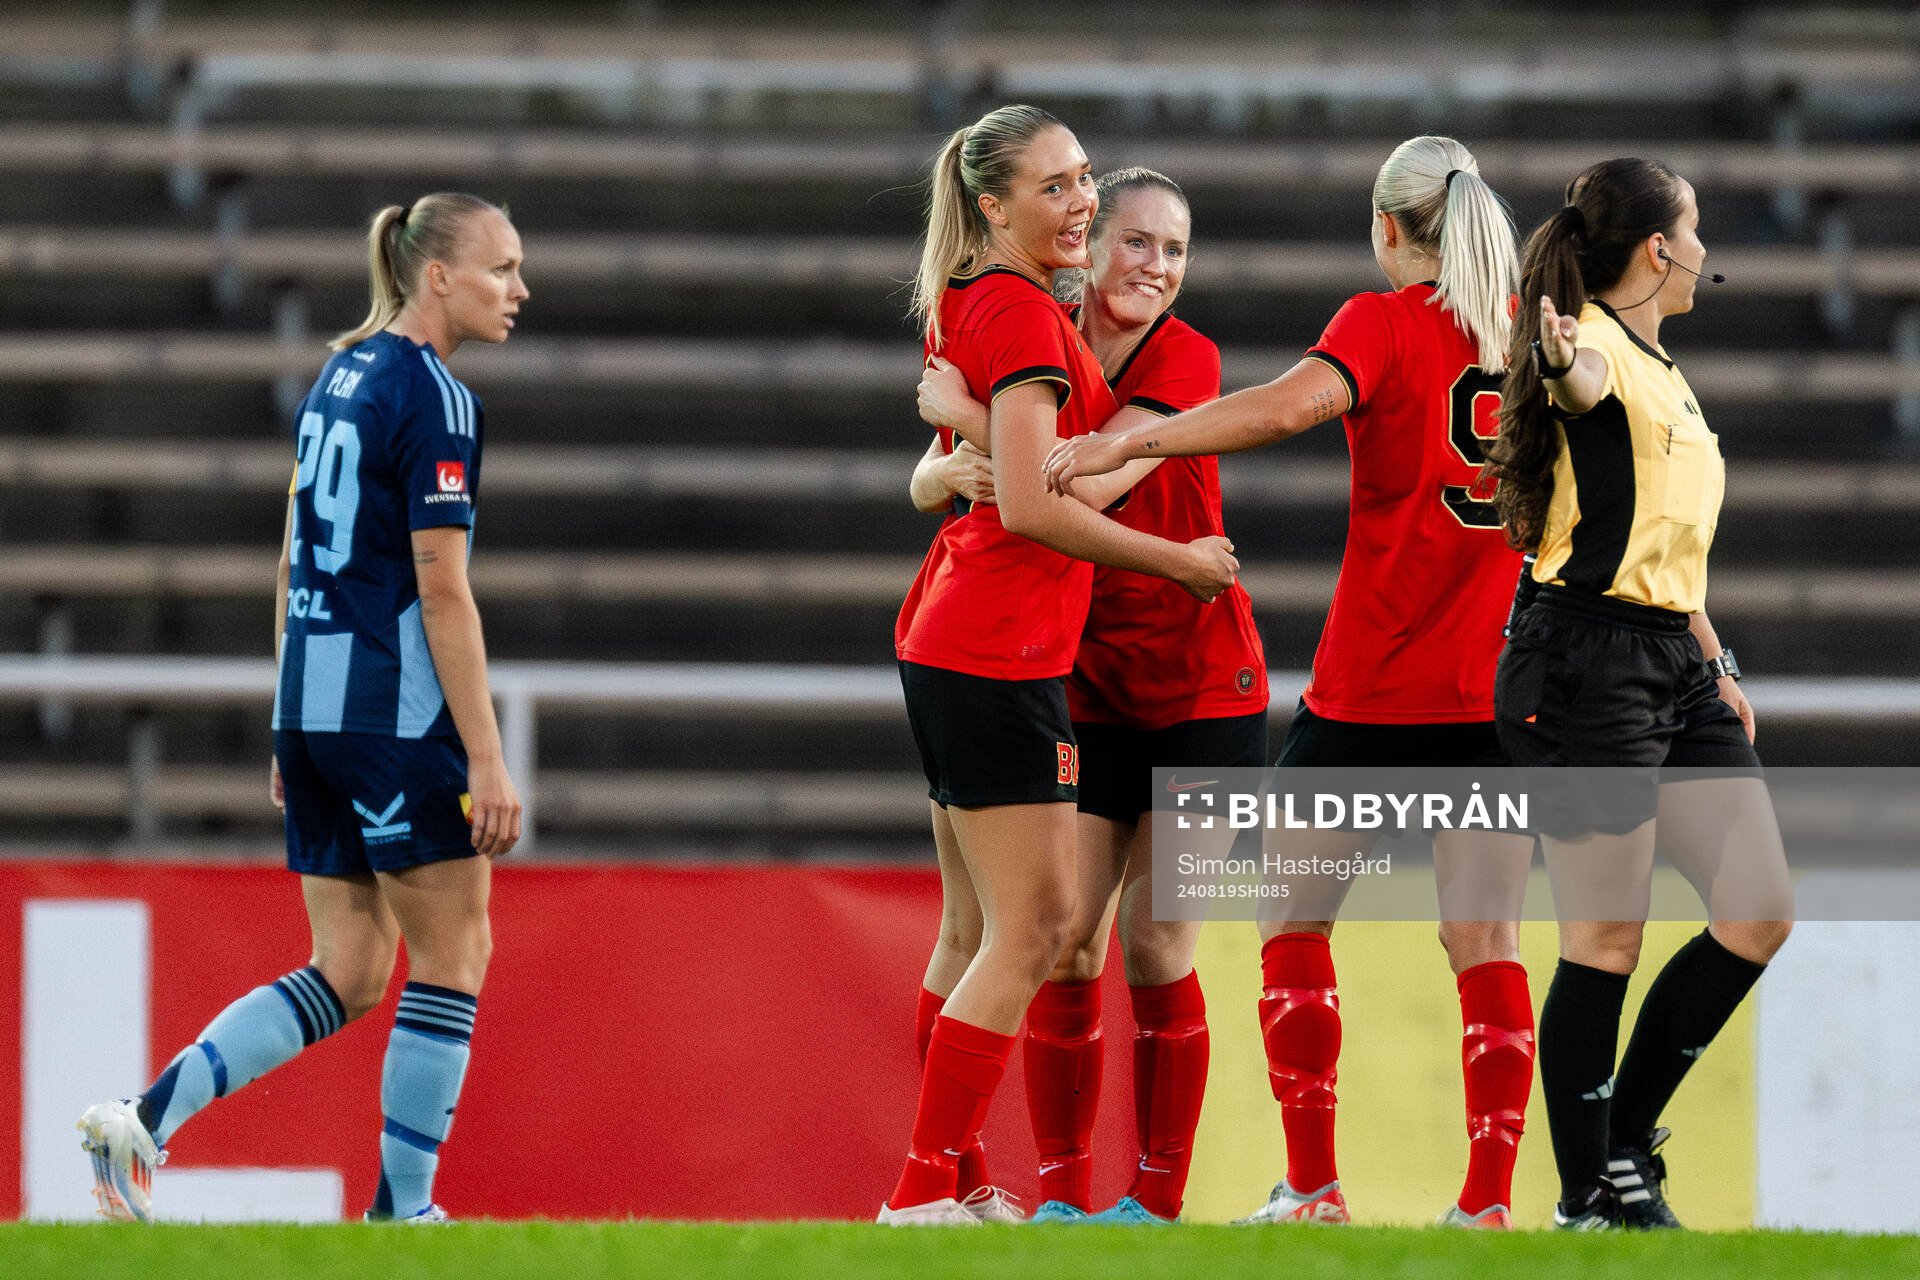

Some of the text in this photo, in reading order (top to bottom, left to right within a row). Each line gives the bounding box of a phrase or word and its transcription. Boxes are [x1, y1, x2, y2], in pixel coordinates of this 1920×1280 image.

[290, 411, 361, 575] 29
[424, 493, 461, 504] SVENSKA
[1441, 364, 1509, 530] 9
